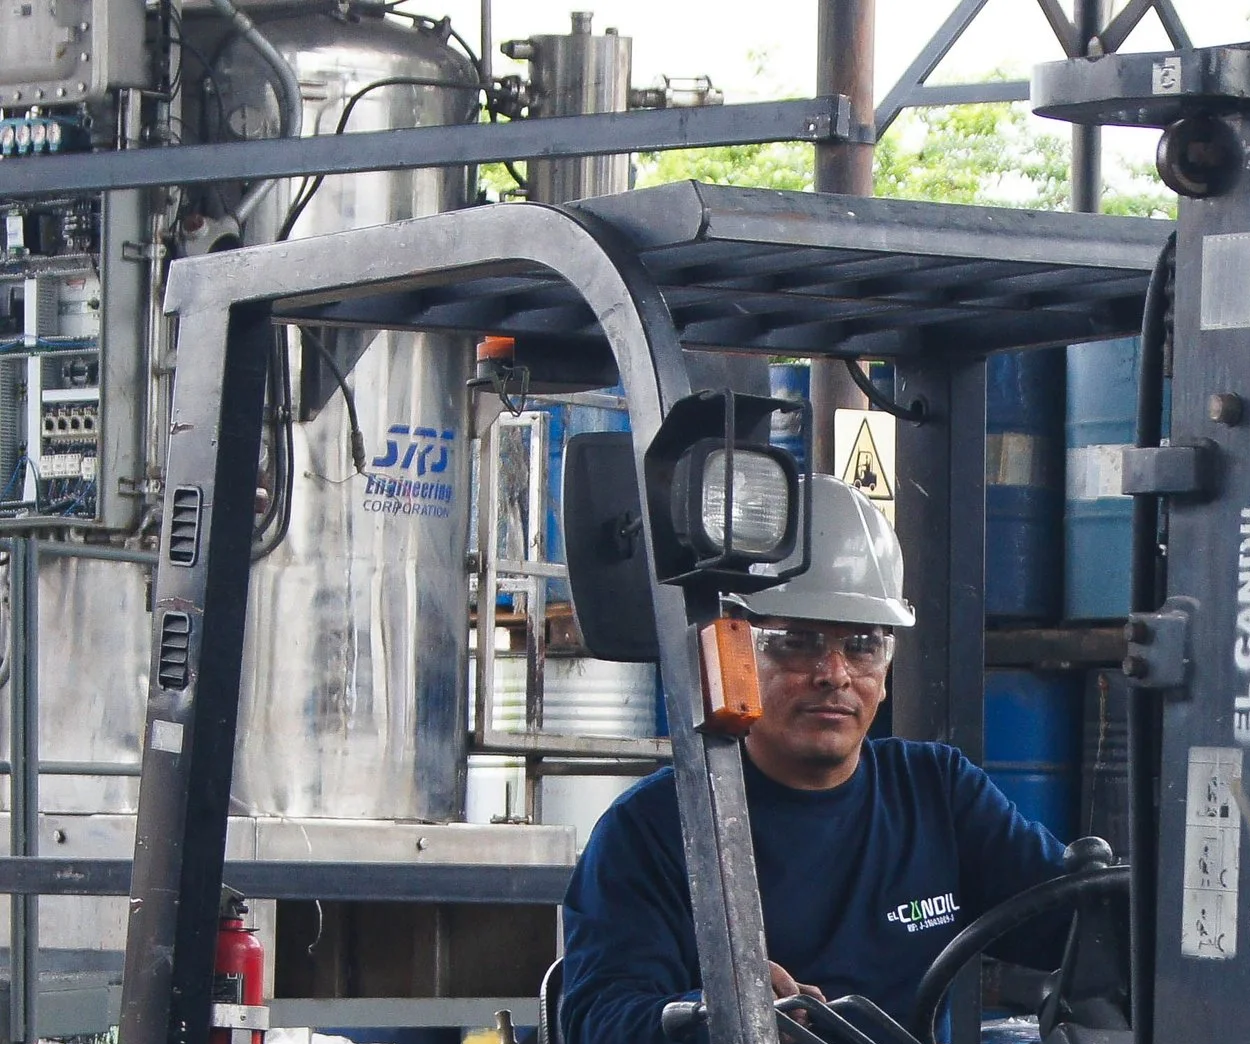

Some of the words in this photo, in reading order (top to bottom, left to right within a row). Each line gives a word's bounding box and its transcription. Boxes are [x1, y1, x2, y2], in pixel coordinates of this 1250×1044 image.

[365, 473, 453, 504] Engineering
[362, 499, 450, 518] CORPORATION
[887, 911, 900, 922] EL
